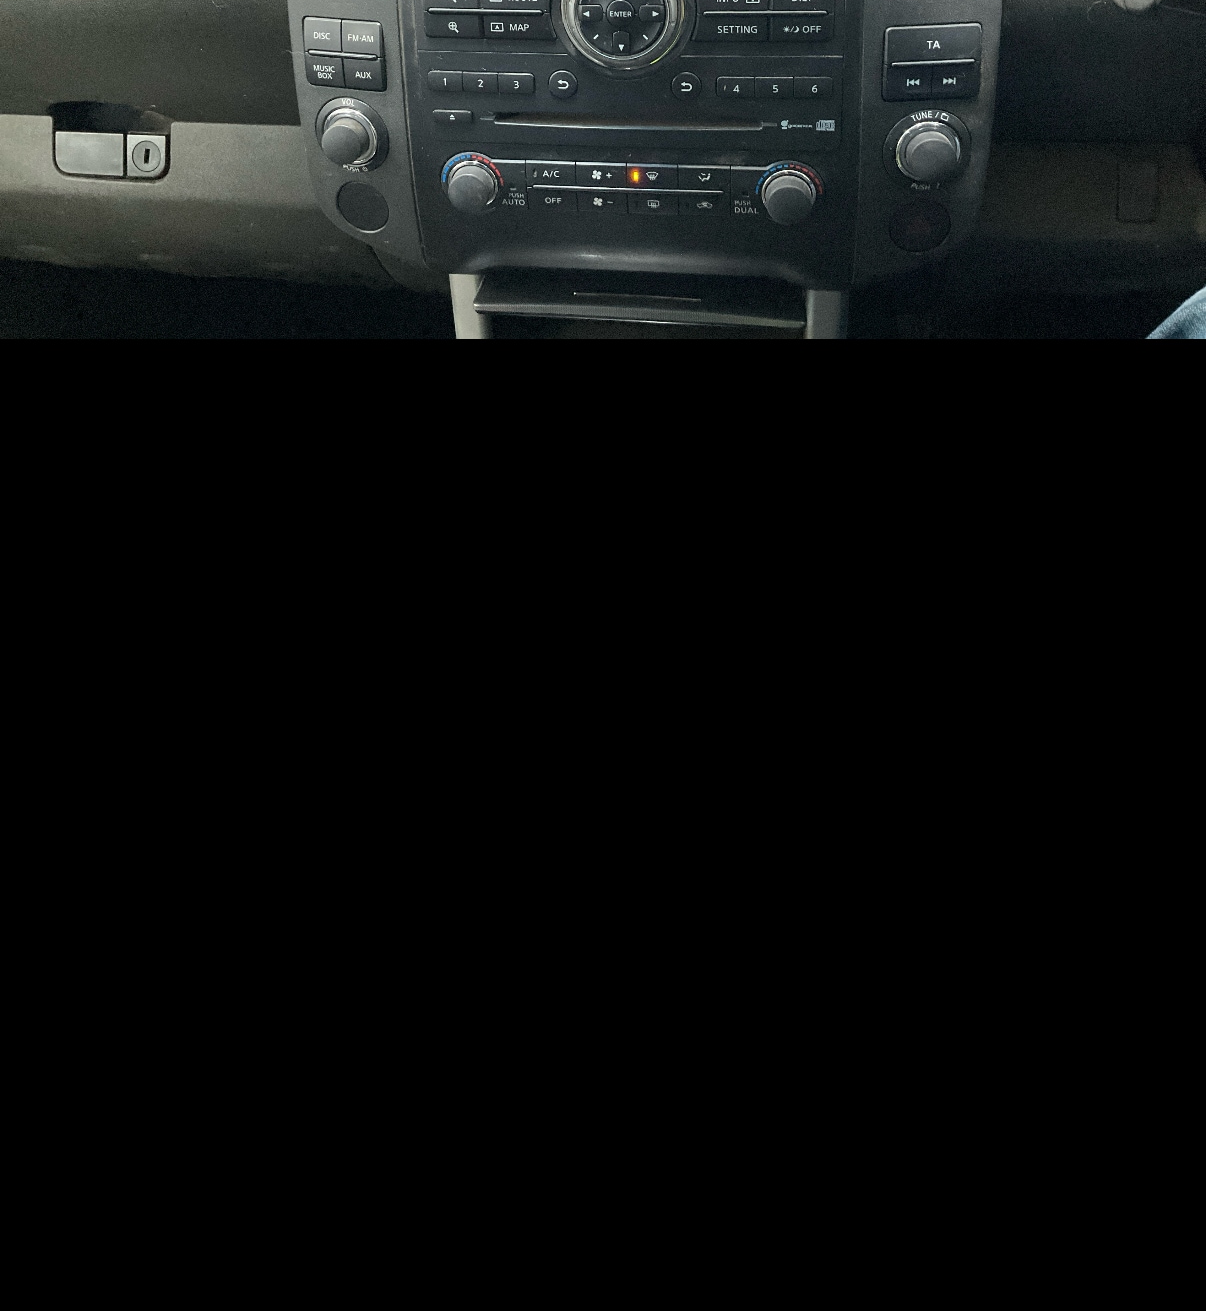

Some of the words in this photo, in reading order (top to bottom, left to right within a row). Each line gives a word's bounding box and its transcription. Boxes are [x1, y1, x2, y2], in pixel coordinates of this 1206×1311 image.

[609, 10, 632, 18] ENTER
[509, 23, 530, 32] MAP
[717, 25, 758, 34] SETTING
[802, 25, 822, 33] OFF
[313, 31, 331, 40] DISC
[926, 40, 941, 50] TA
[313, 64, 336, 73] MUSIC
[317, 71, 333, 80] BOX
[355, 71, 372, 80] AUX
[443, 77, 447, 87] 1
[477, 79, 484, 88] 2
[513, 80, 520, 89] 3
[732, 84, 740, 94] 4
[772, 84, 779, 94] 5
[811, 84, 818, 94] 6
[341, 98, 354, 107] VOL
[910, 110, 933, 122] TUNE
[542, 170, 560, 178] A/C
[501, 198, 526, 206] AUTO
[734, 206, 760, 215] DUAL
